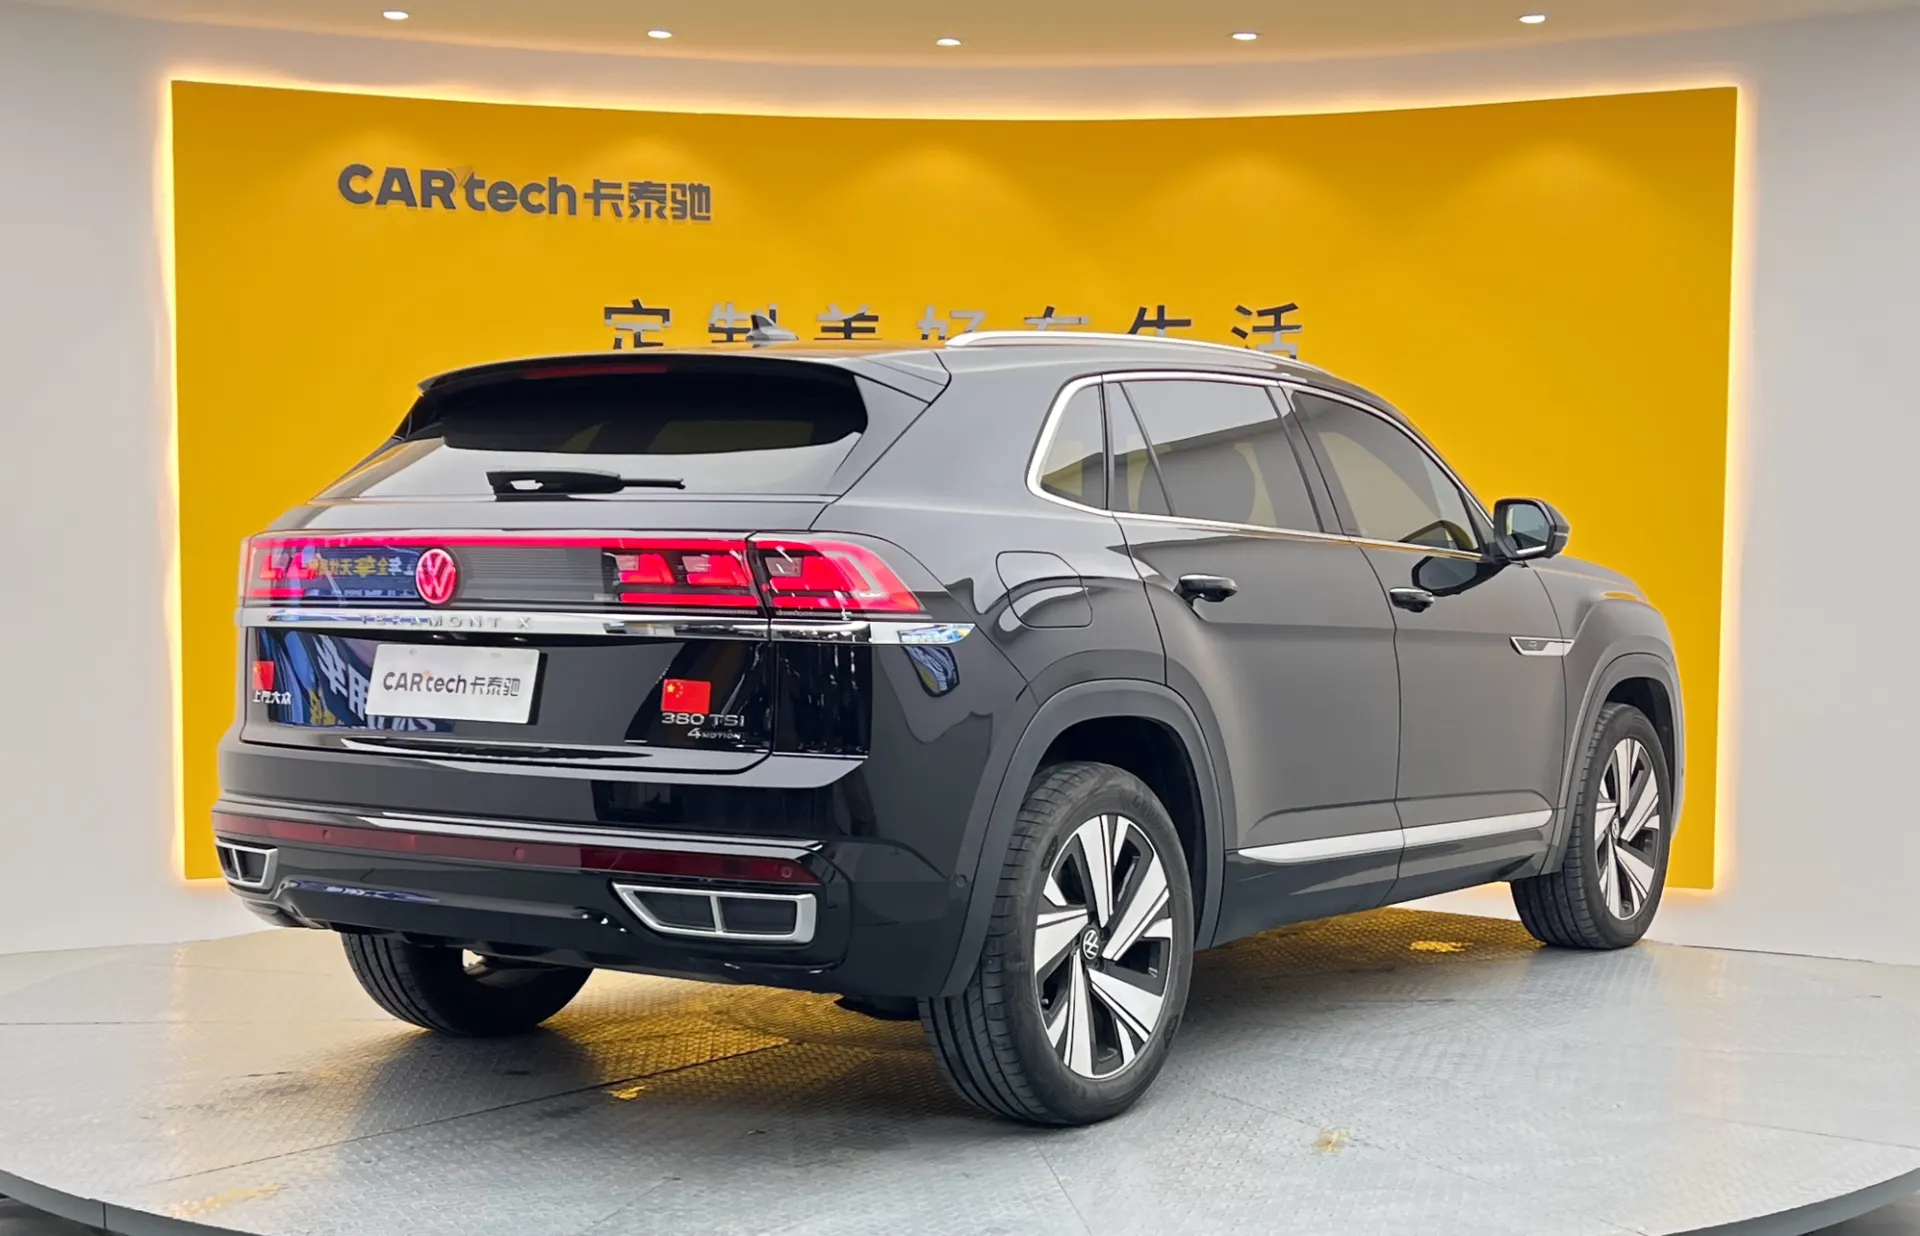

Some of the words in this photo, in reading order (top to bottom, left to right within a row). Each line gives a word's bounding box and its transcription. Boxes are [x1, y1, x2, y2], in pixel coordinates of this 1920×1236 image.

[338, 163, 577, 216] CARtech
[584, 178, 711, 221] 卡泰驰
[518, 615, 532, 629] X
[383, 671, 467, 694] CARtech
[470, 675, 521, 697] 卡泰驰
[661, 712, 705, 725] 380
